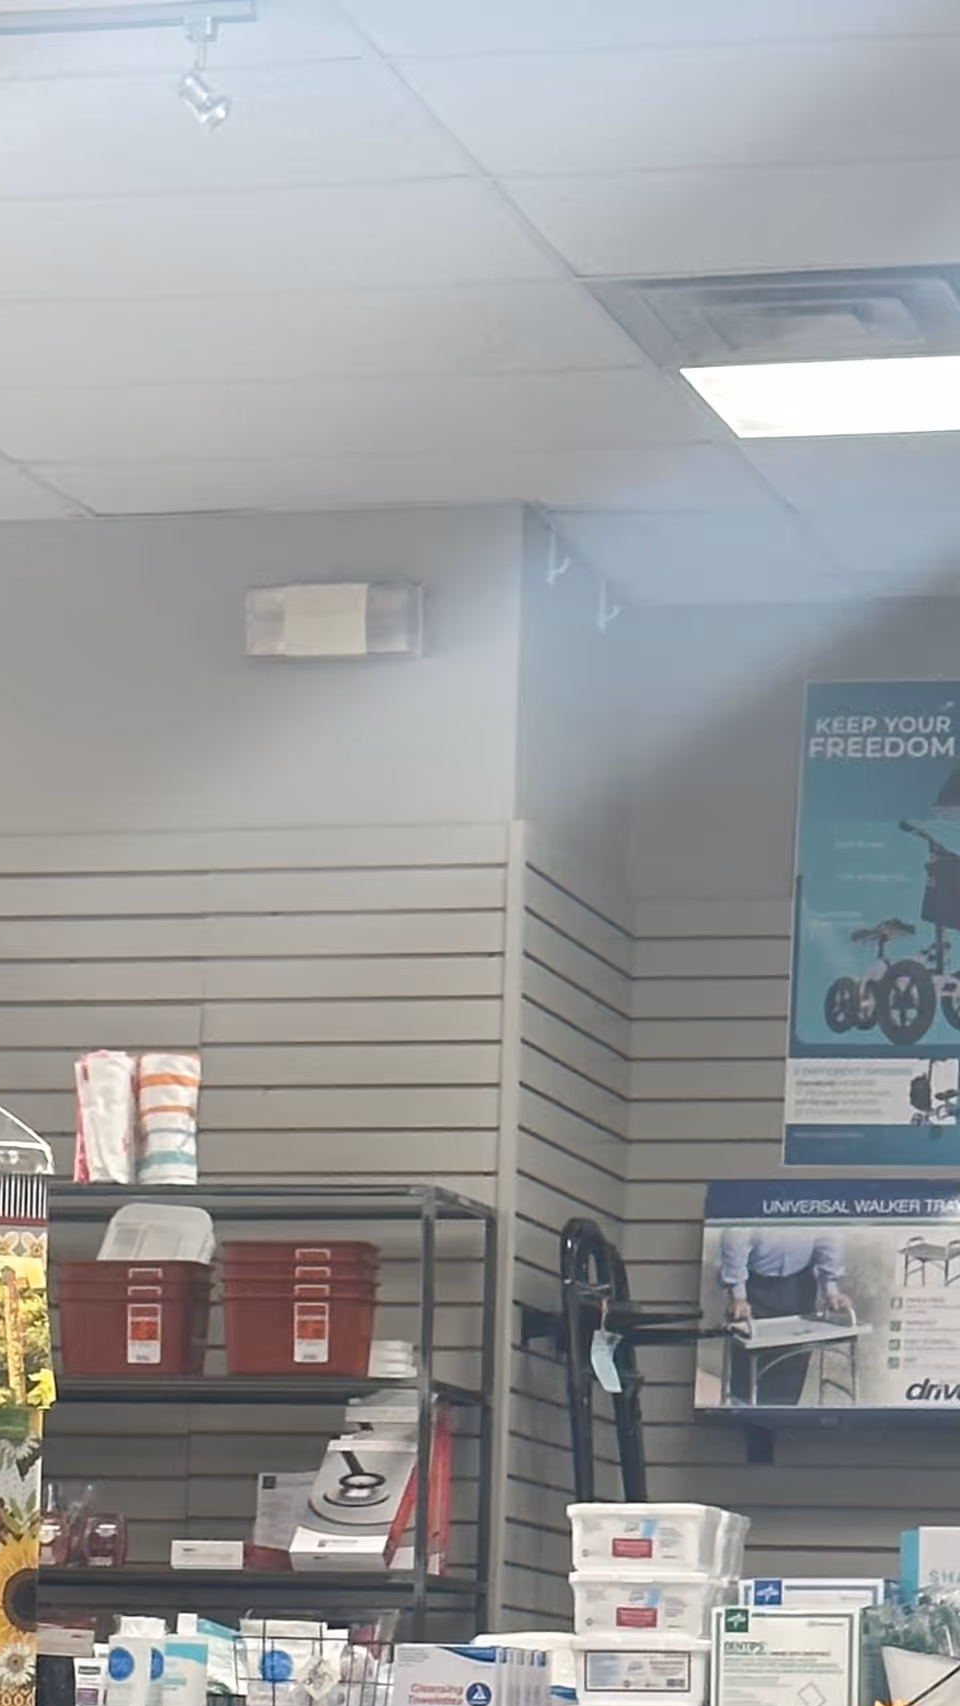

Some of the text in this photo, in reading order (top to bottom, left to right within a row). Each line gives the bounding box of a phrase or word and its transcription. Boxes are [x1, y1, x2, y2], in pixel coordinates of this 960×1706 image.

[815, 715, 953, 735] KEEP YOUR
[808, 736, 955, 758] FREEDOM
[763, 1199, 851, 1214] UNIVERSAL
[854, 1199, 920, 1214] WALKER
[906, 1377, 960, 1401] driv
